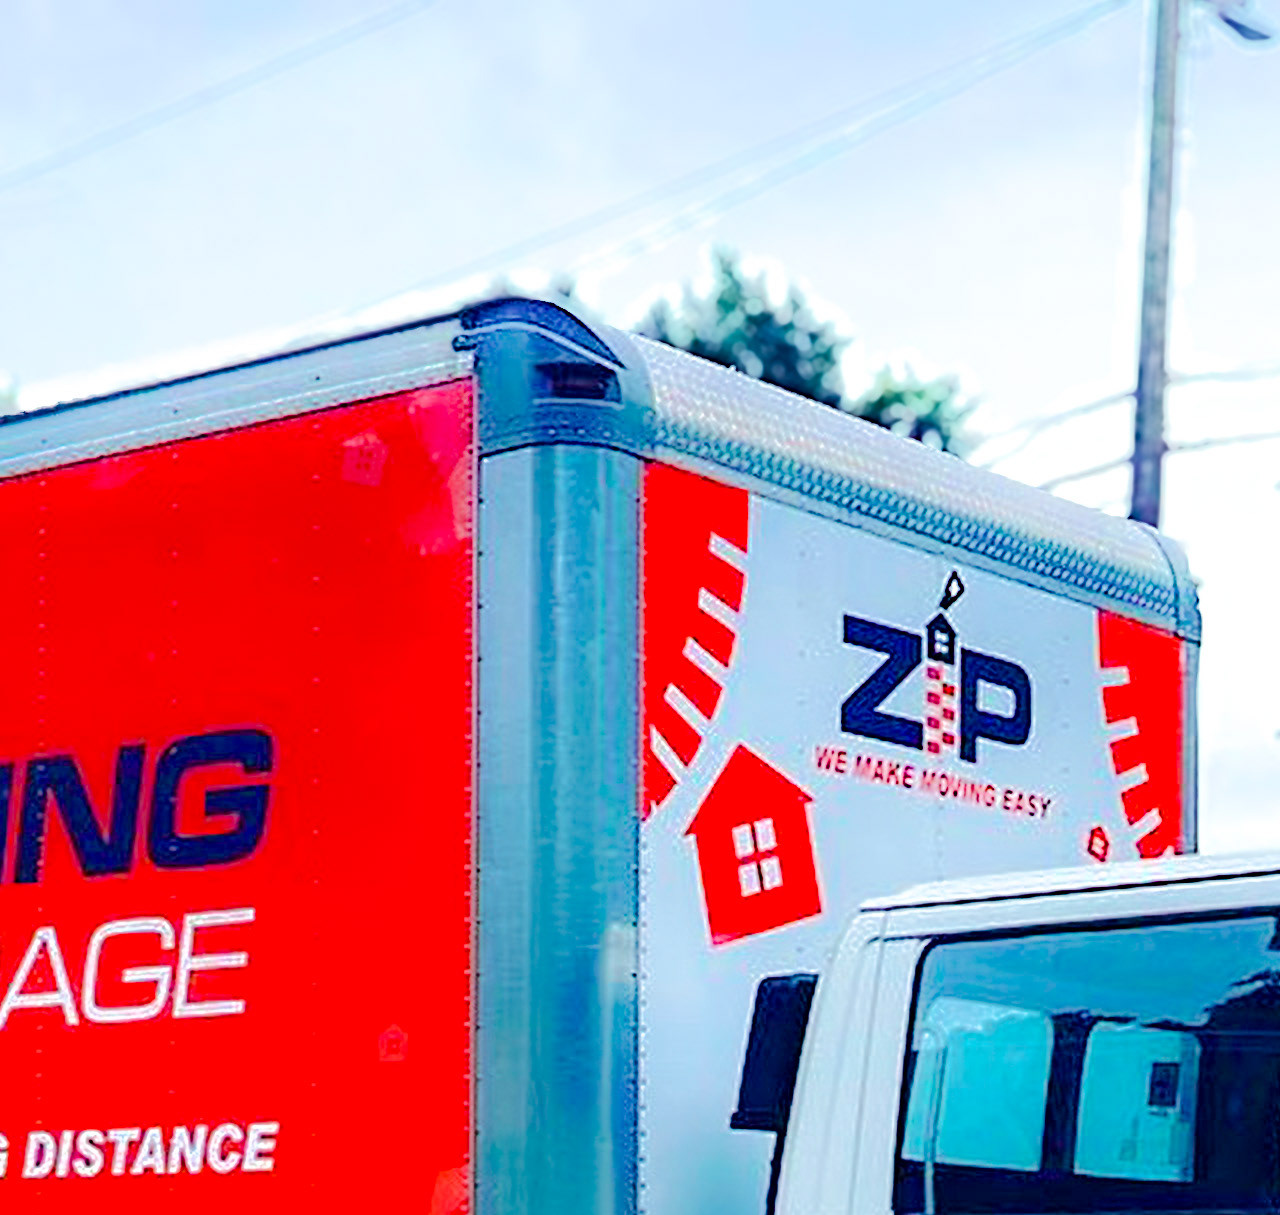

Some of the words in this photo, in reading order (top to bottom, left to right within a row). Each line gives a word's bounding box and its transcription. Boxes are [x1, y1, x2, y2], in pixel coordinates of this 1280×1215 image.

[817, 746, 847, 773] WE
[856, 754, 914, 790] MAKE
[921, 769, 996, 807] MOVING
[1002, 788, 1052, 818] EASY
[22, 1122, 279, 1178] DISTANCE
